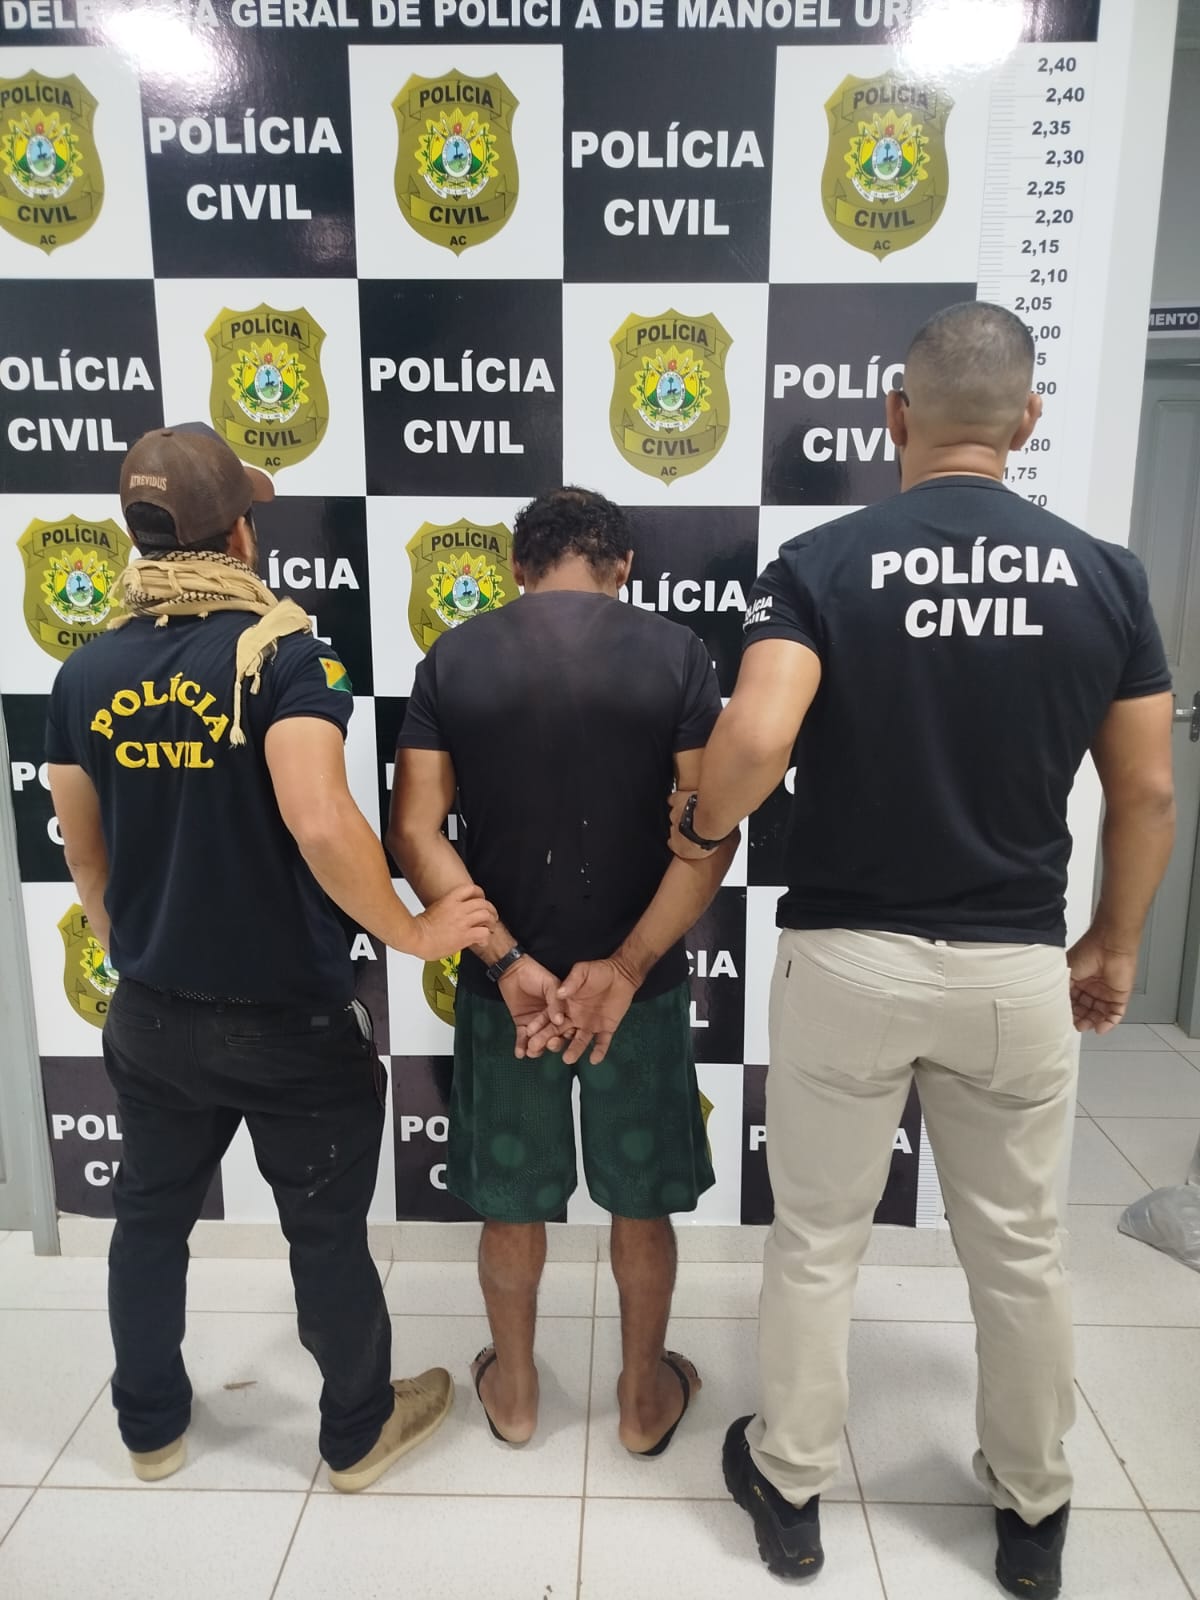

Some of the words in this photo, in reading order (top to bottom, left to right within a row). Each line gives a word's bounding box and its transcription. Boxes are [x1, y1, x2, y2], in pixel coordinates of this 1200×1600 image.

[231, 0, 359, 28] GERAL
[372, 0, 422, 27] DE
[615, 0, 664, 28] DE
[677, 0, 841, 28] MANOEL
[1037, 57, 1077, 76] 2,40
[419, 80, 494, 109] POLÍCIA
[1045, 87, 1085, 106] 2,40
[149, 108, 342, 154] POLÍCIA
[1031, 120, 1071, 139] 2,35
[571, 122, 765, 168] POLÍCIA
[1045, 150, 1084, 168] 2,30
[187, 184, 312, 220] CIVIL
[1026, 181, 1066, 199] 2,25
[17, 205, 78, 224] CIVIL
[429, 205, 490, 225] CIVIL
[603, 199, 730, 235] CIVIL
[854, 210, 915, 229] CIVIL
[1035, 209, 1074, 228] 2,20
[39, 234, 57, 246] AC
[449, 235, 467, 246] AC
[873, 239, 891, 251] AC
[1021, 239, 1060, 257] 2,15
[1030, 268, 1068, 286] 2,10
[1014, 296, 1052, 314] 2,05
[231, 314, 302, 339] POLÍCIA
[637, 320, 709, 346] POLÍCIA
[0, 348, 155, 392] OLÍCIA
[368, 350, 556, 393] POLÍCIA
[773, 354, 906, 399] POLÍC
[8, 418, 128, 451] CIVIL
[244, 429, 302, 447] CIVIL
[403, 419, 525, 454] CIVIL
[802, 427, 897, 462] CIVI
[642, 438, 700, 456] CIVIL
[264, 456, 281, 467] AC
[660, 466, 678, 477] AC
[42, 524, 111, 548] POLÍCIA
[431, 528, 500, 553] POLÍCIA
[871, 536, 1079, 590] POLÍCIA
[904, 597, 1044, 639] CIVIL
[90, 671, 230, 744] POLÍCIA
[114, 741, 215, 769] CIVIL
